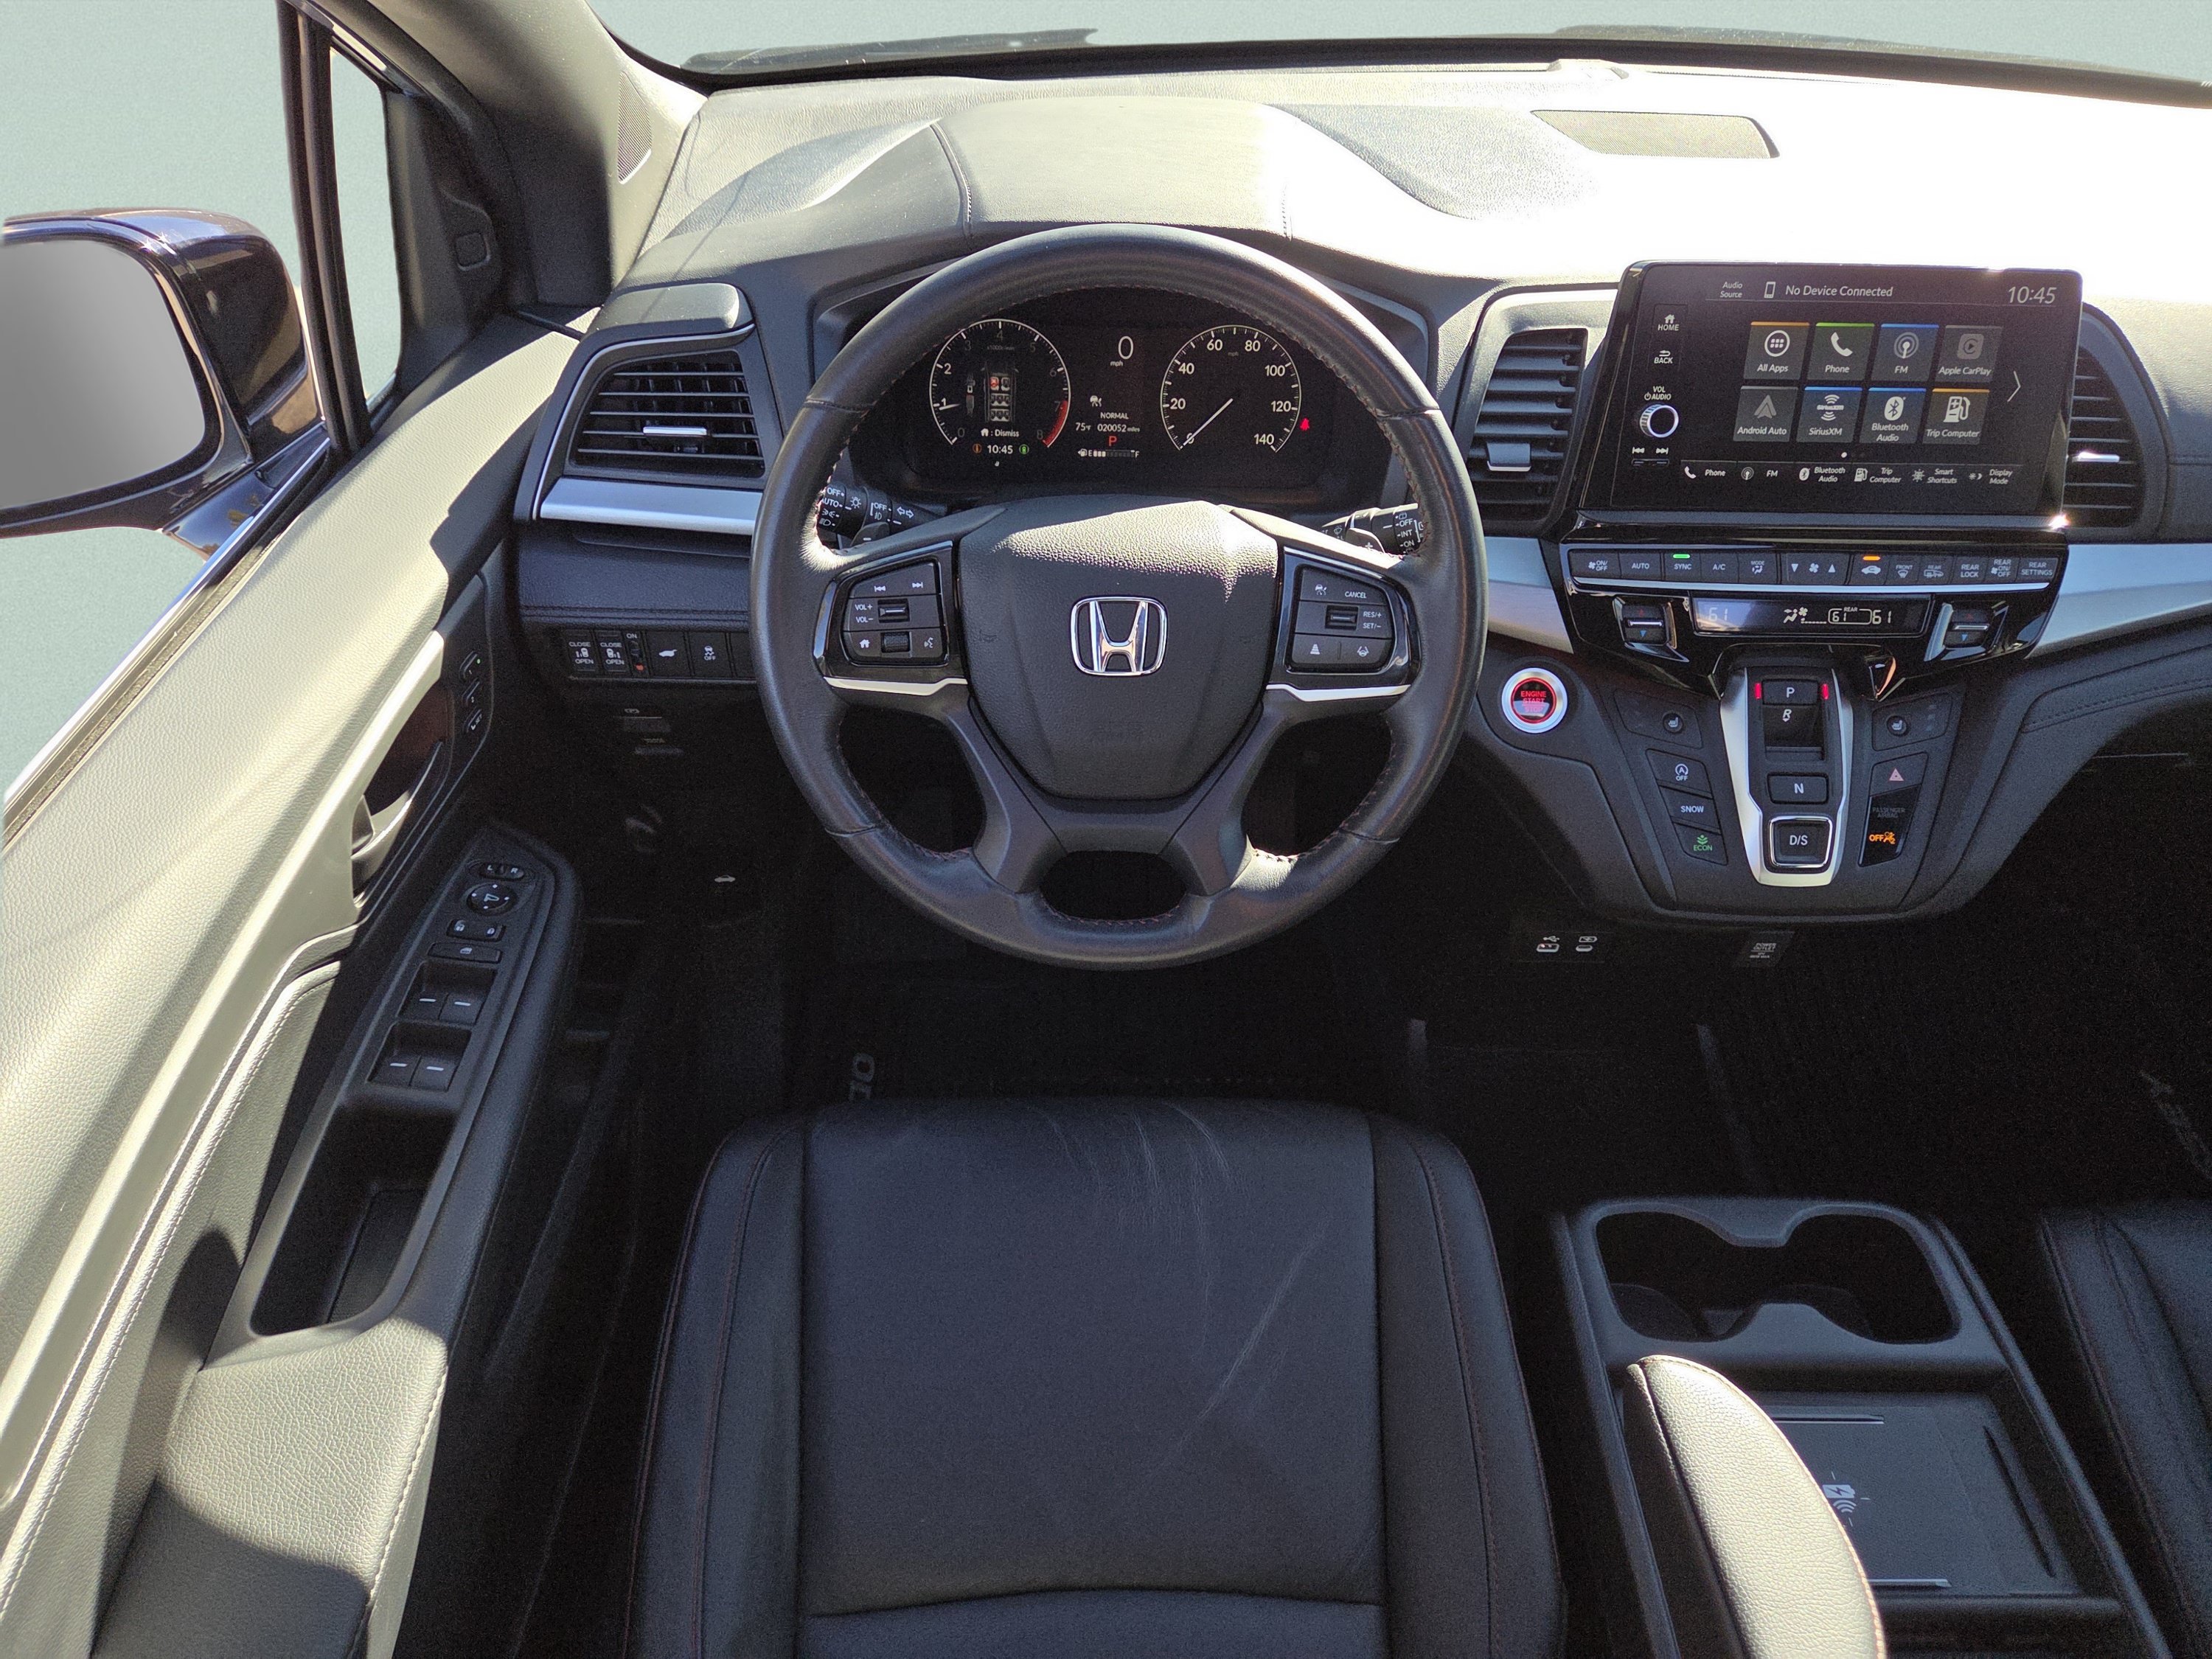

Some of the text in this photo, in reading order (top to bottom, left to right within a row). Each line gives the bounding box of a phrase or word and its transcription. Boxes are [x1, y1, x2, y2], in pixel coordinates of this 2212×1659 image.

[1785, 285, 1893, 297] No Device Connected
[2007, 286, 2056, 304] 10:45
[1657, 323, 1679, 332] HOME
[997, 331, 1004, 341] 4
[1118, 336, 1134, 359] 0
[1207, 340, 1223, 351] 60
[1245, 340, 1261, 352] 80
[1653, 356, 1673, 365] BACK
[944, 363, 952, 375] 2
[1049, 368, 1057, 378] 6
[1178, 362, 1195, 375] 40
[1265, 365, 1286, 377] 100
[1757, 364, 1789, 374] All Apps
[1825, 365, 1850, 373] Phone
[1894, 366, 1908, 374] FM
[1938, 366, 1992, 378] Apple CarPlay
[1652, 392, 1672, 401] AUDIO
[941, 398, 946, 406] 1
[1170, 398, 1186, 410] 20
[1270, 400, 1291, 412] 120
[1097, 424, 1127, 432] 020052
[1737, 426, 1787, 436] Android Auto
[1809, 428, 1843, 436] SiriusXM
[1871, 422, 1909, 432] Bluetooth
[958, 428, 965, 438] 0
[1877, 432, 1899, 442] Audio
[1927, 428, 1980, 440] Trip Computer
[1108, 435, 1117, 446] P
[1254, 434, 1274, 445] 140
[987, 445, 1013, 454] 10:45
[1705, 469, 1726, 477] Phone
[1766, 469, 1778, 477] FM
[1814, 466, 1846, 475] Bluetooth
[1881, 467, 1893, 476] Trip
[1935, 468, 1953, 476] Smart
[1989, 469, 2013, 478] Display
[1818, 474, 1838, 483] Audio
[1870, 476, 1901, 484] Computer
[1927, 476, 1957, 484] Shortcuts
[1989, 477, 2008, 485] Mode
[827, 487, 841, 497] OFF
[821, 498, 839, 508] AUTO
[874, 502, 887, 511] OFF
[1399, 518, 1413, 527] OFF
[1401, 529, 1412, 538] INT
[1404, 539, 1415, 547] ON
[1712, 563, 1726, 571] A/C
[1708, 607, 1728, 623] 61
[1832, 612, 1847, 622] 61
[1872, 610, 1892, 625] 61
[1786, 687, 1795, 698] P
[1783, 709, 1792, 719] R
[1794, 783, 1804, 794] N
[1790, 835, 1808, 845] D/S
[1869, 834, 1884, 842] OFF
